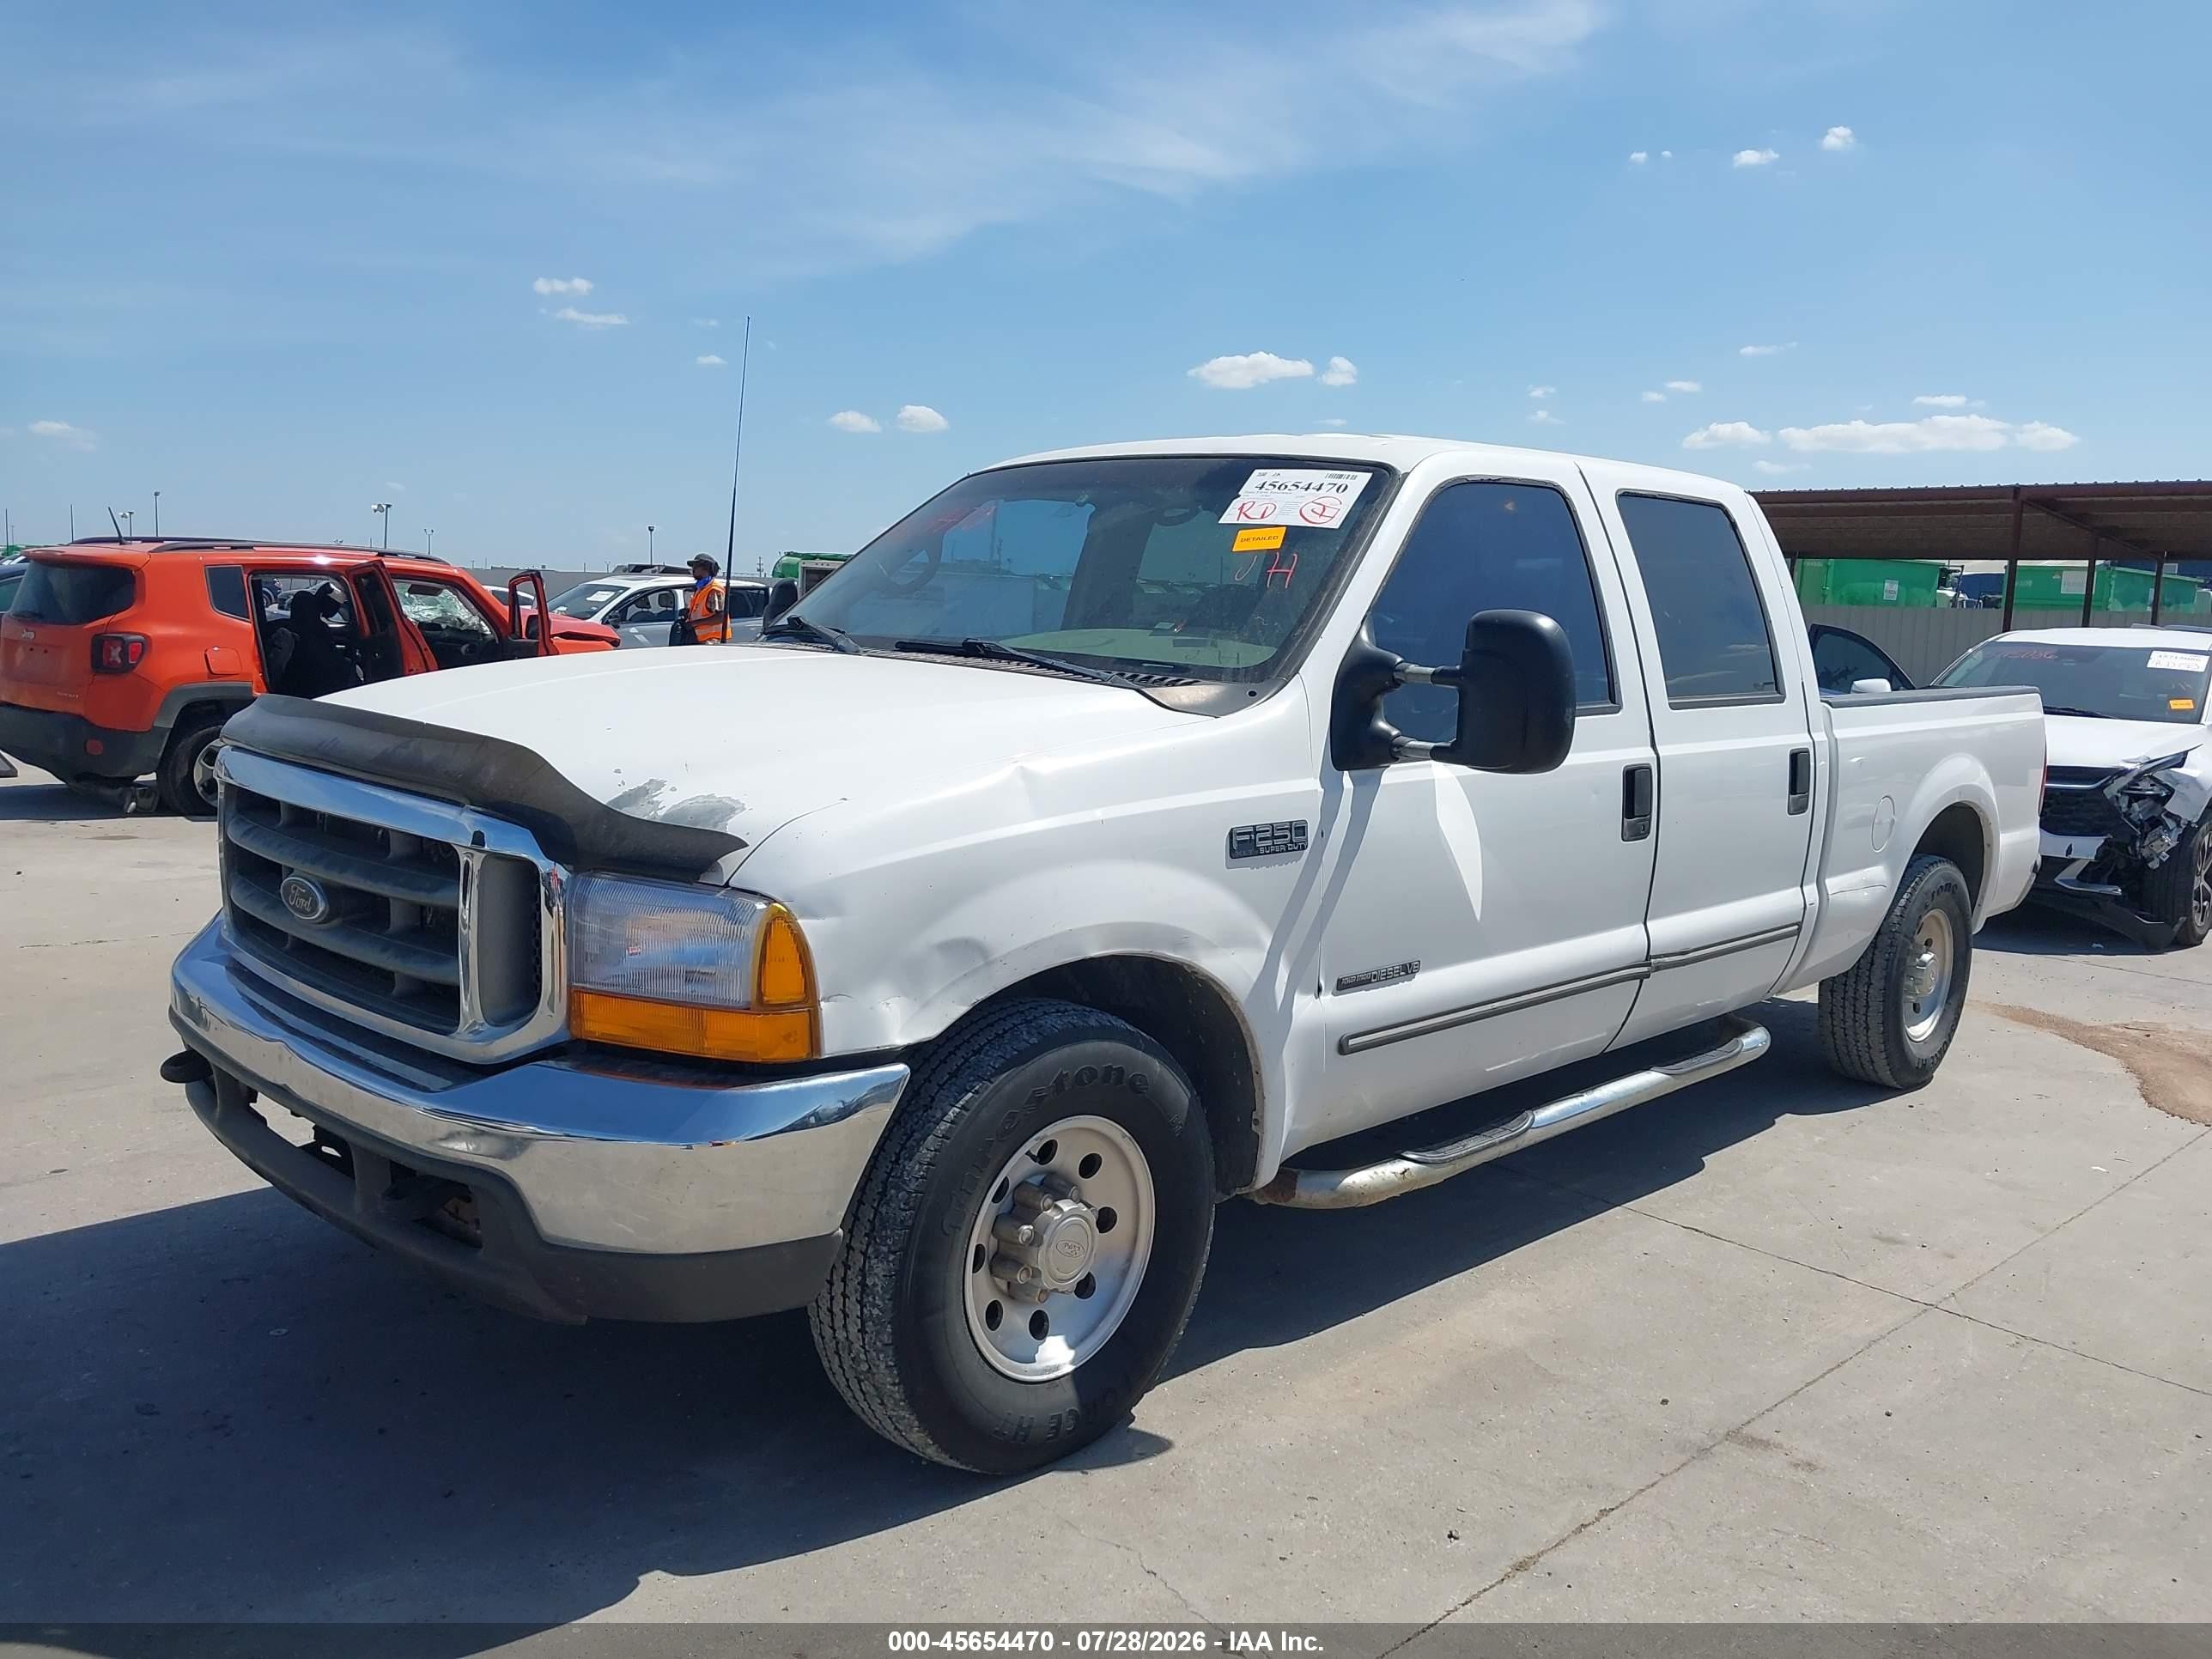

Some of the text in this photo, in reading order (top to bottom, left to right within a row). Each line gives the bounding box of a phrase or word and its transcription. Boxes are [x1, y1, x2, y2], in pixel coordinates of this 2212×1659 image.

[1255, 480, 1349, 494] 45654470
[1240, 534, 1279, 543] DETAILED
[1259, 845, 1285, 854] SUPER
[289, 884, 312, 912] Ford
[1370, 965, 1406, 982] DIESEL
[1407, 962, 1419, 974] V8
